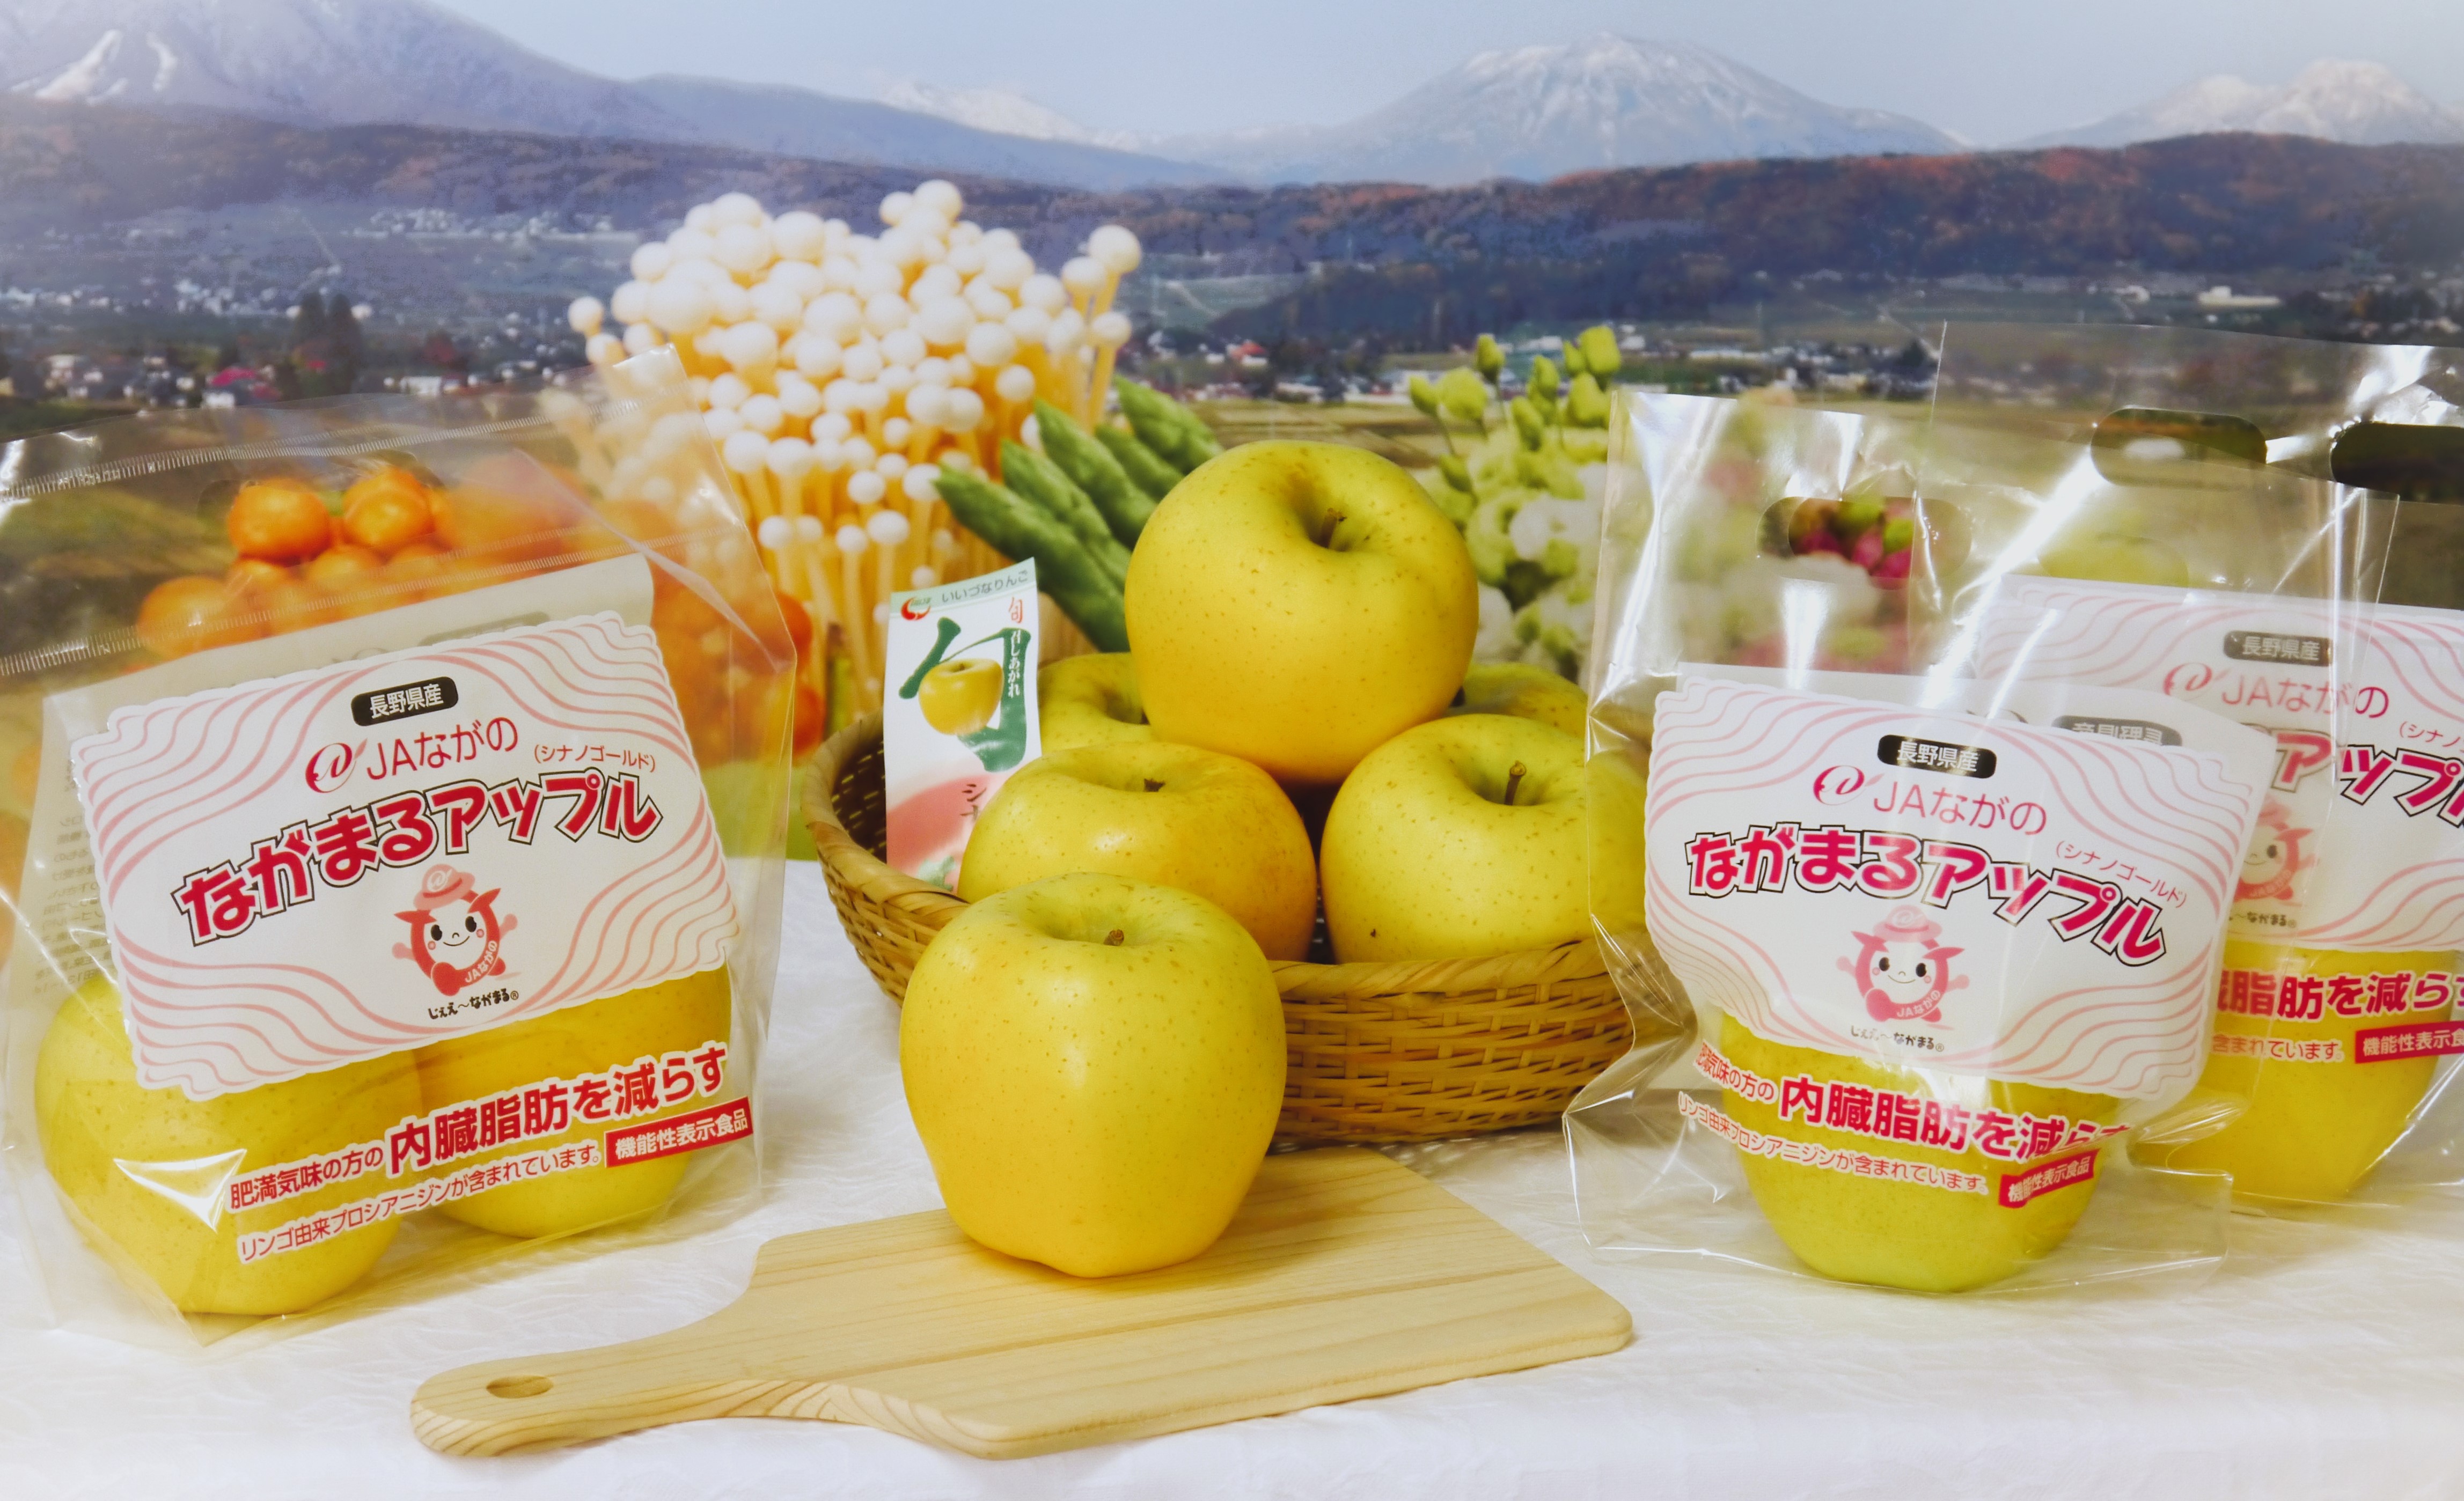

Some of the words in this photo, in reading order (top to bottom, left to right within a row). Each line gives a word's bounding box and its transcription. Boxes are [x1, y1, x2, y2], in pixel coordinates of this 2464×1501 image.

[942, 569, 1028, 604] いいづなりんご
[2241, 635, 2320, 662] 長野県産
[369, 682, 444, 719] 長野県産
[2221, 673, 2390, 719] JAながの
[366, 717, 519, 780] JAながの
[533, 744, 656, 773] (シナノゴールド)
[1897, 740, 1979, 773] 長野県産
[1873, 782, 2047, 836] JAながの
[171, 767, 663, 946] ながまるアップル
[2055, 840, 2188, 908] (シナノゴールド)
[1685, 821, 2167, 967] ながまるアップル
[230, 1145, 384, 1210] 肥満気味の方の
[390, 1047, 727, 1175] 内臓脂肪を減らす
[615, 1107, 749, 1160] 機能性表示食品
[1678, 1092, 1989, 1194] リンゴ由来プロシアニジンが含まれています。
[241, 1143, 600, 1261] リンゴ由来プロシアニジンが含まれています。
